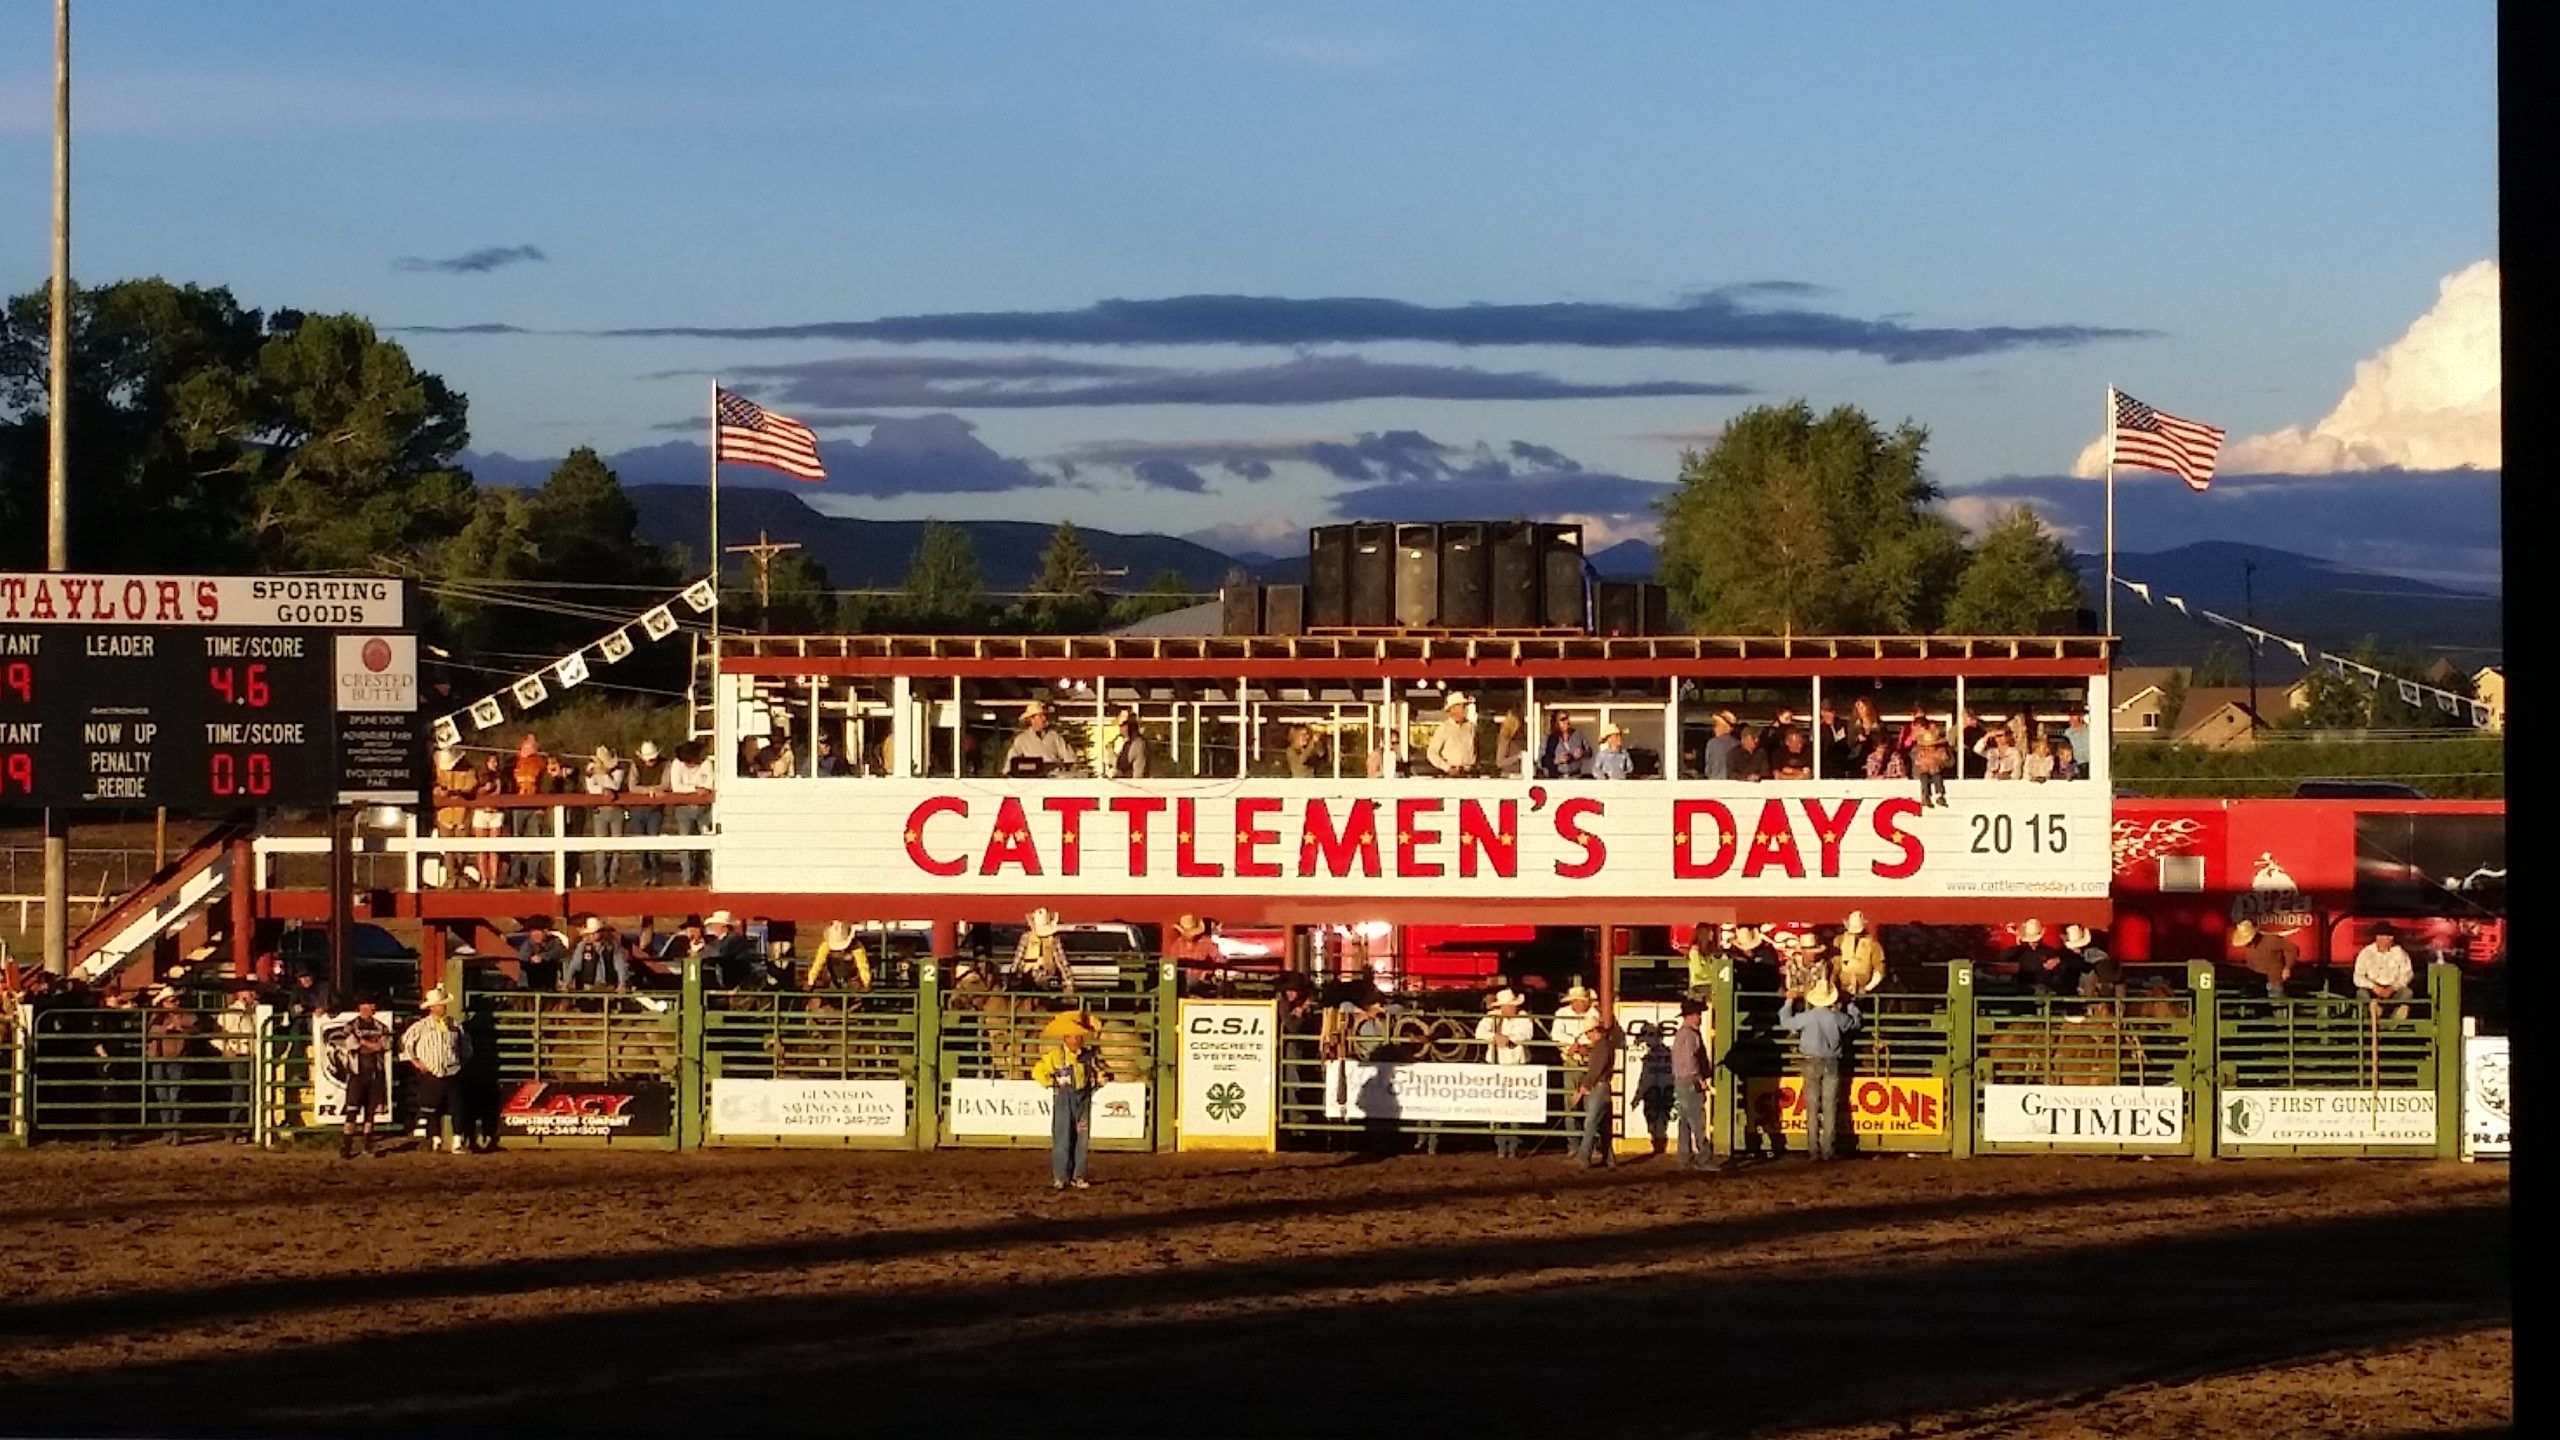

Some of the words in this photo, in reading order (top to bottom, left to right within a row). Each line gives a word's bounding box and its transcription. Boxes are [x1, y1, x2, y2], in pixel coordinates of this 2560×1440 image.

[1, 578, 219, 621] TAYLOR'S
[252, 580, 387, 601] SPORTING
[277, 604, 365, 623] GOODS
[86, 635, 154, 657] LEADER
[204, 636, 305, 658] TIME/SCORE
[209, 664, 270, 707] 4.6
[85, 723, 122, 744] NOW
[134, 723, 157, 744] UP
[204, 723, 305, 744] TIME/SCORE
[90, 751, 151, 773] PENALTY
[210, 753, 271, 795] 0.0
[97, 777, 146, 798] RERIDE
[904, 786, 1607, 878] CATTLEMEN'S
[1673, 797, 1925, 879] DAYS
[689, 962, 697, 982] 1
[923, 965, 936, 982] 2
[1163, 963, 1175, 981] 3
[1718, 965, 1731, 982] 4
[1958, 968, 1970, 986] 5
[2200, 972, 2212, 990] 6
[1190, 1017, 1265, 1036] C.S.I.
[1391, 1070, 1543, 1088] Chamberland
[501, 1080, 635, 1116] LACY
[957, 1098, 1014, 1116] BANK
[2269, 1096, 2325, 1113] FIRST
[2331, 1096, 2434, 1113] GUNNISON
[2041, 1107, 2176, 1137] TIMES
